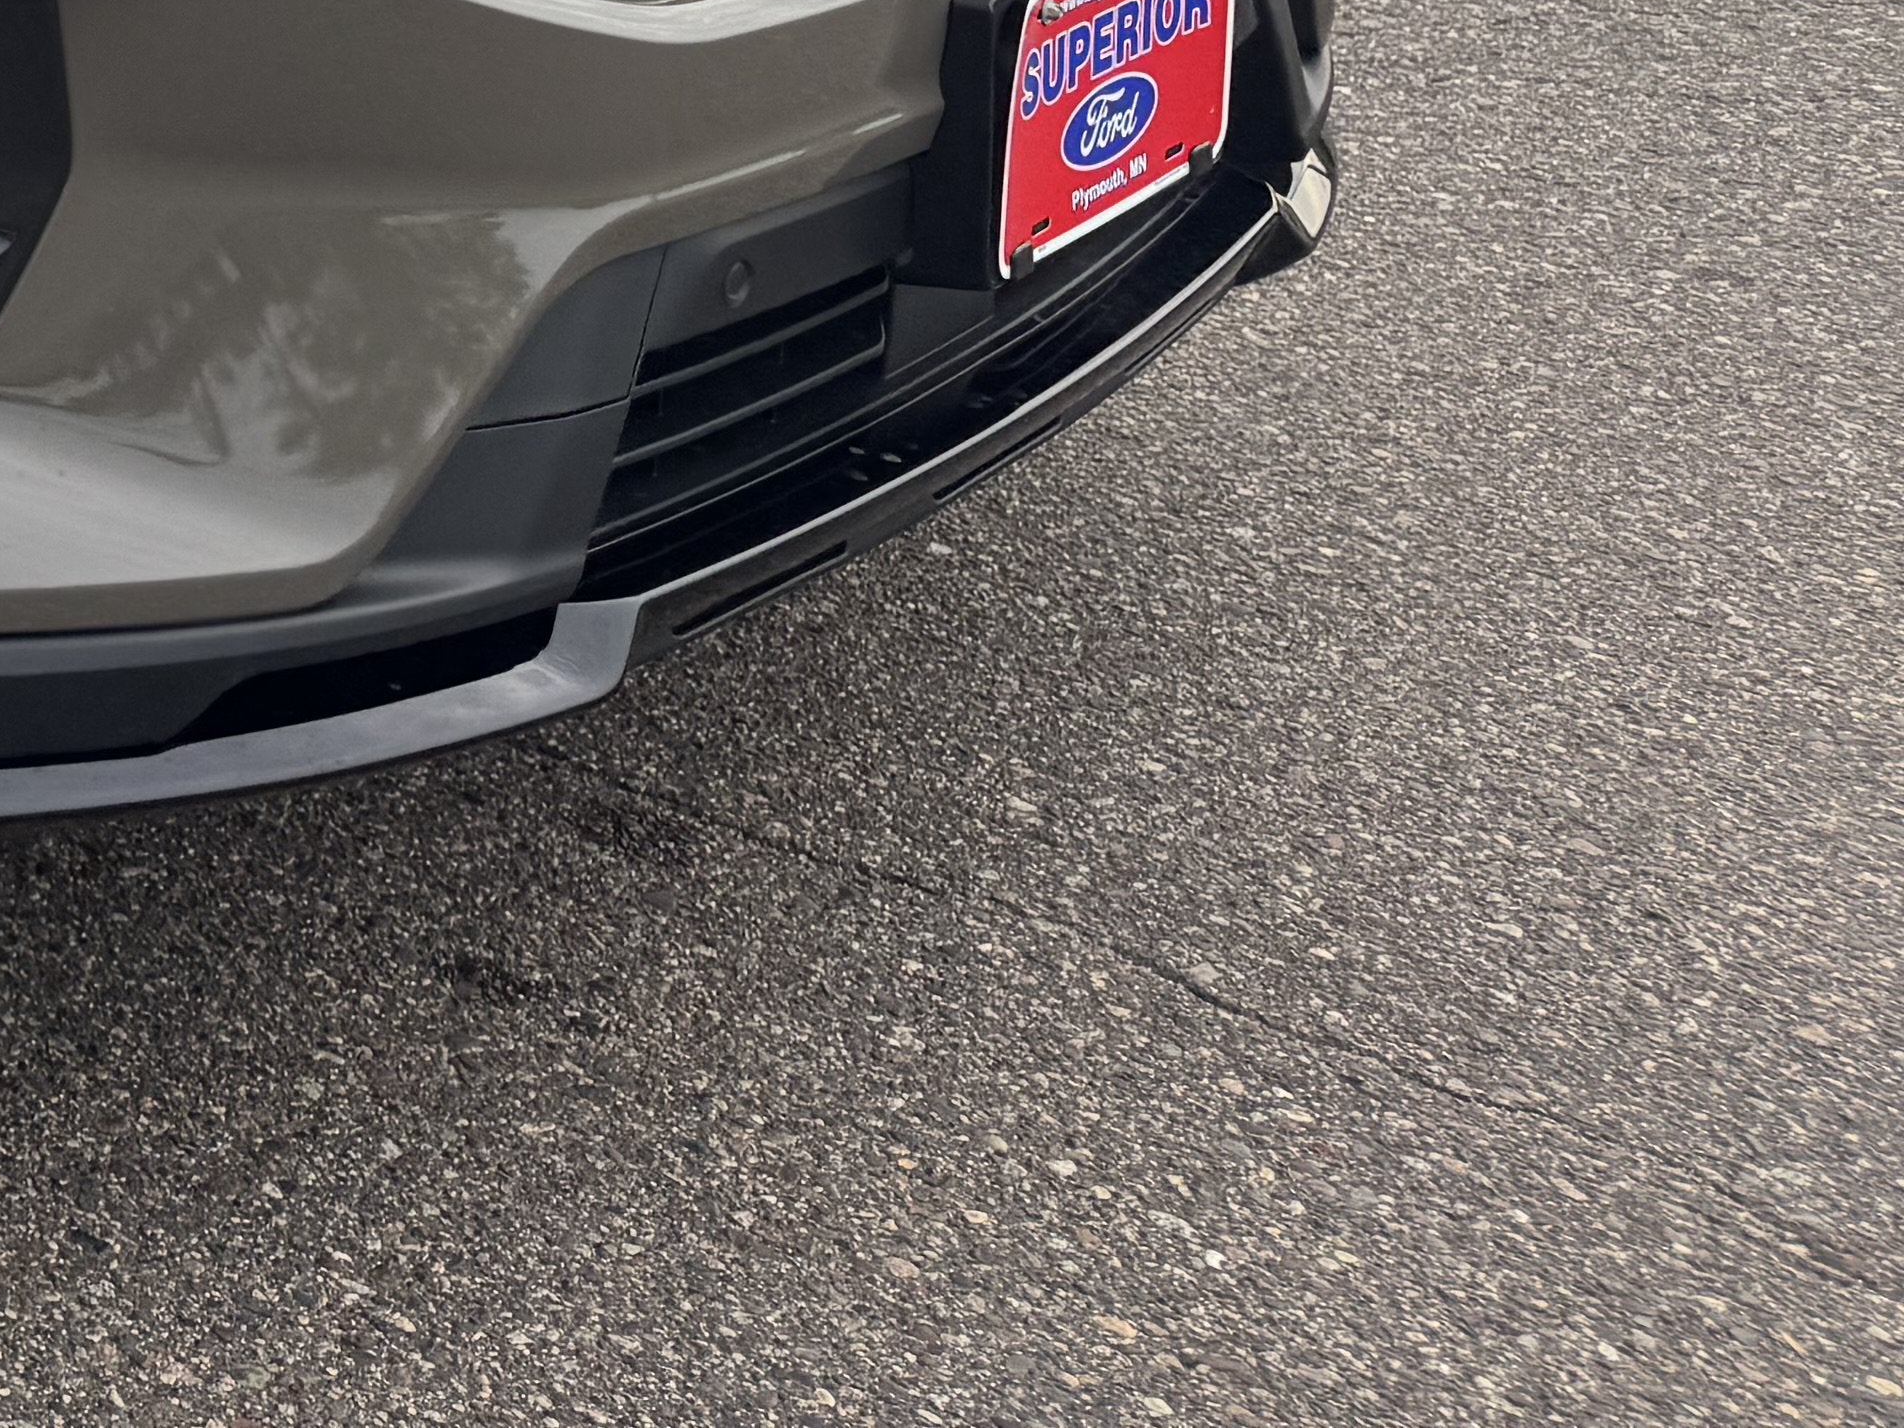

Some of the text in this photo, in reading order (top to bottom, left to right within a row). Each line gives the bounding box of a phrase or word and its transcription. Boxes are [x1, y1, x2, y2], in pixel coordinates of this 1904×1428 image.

[1080, 87, 1139, 157] Ford
[1071, 168, 1128, 211] Plymouth,
[1129, 152, 1147, 179] MN
